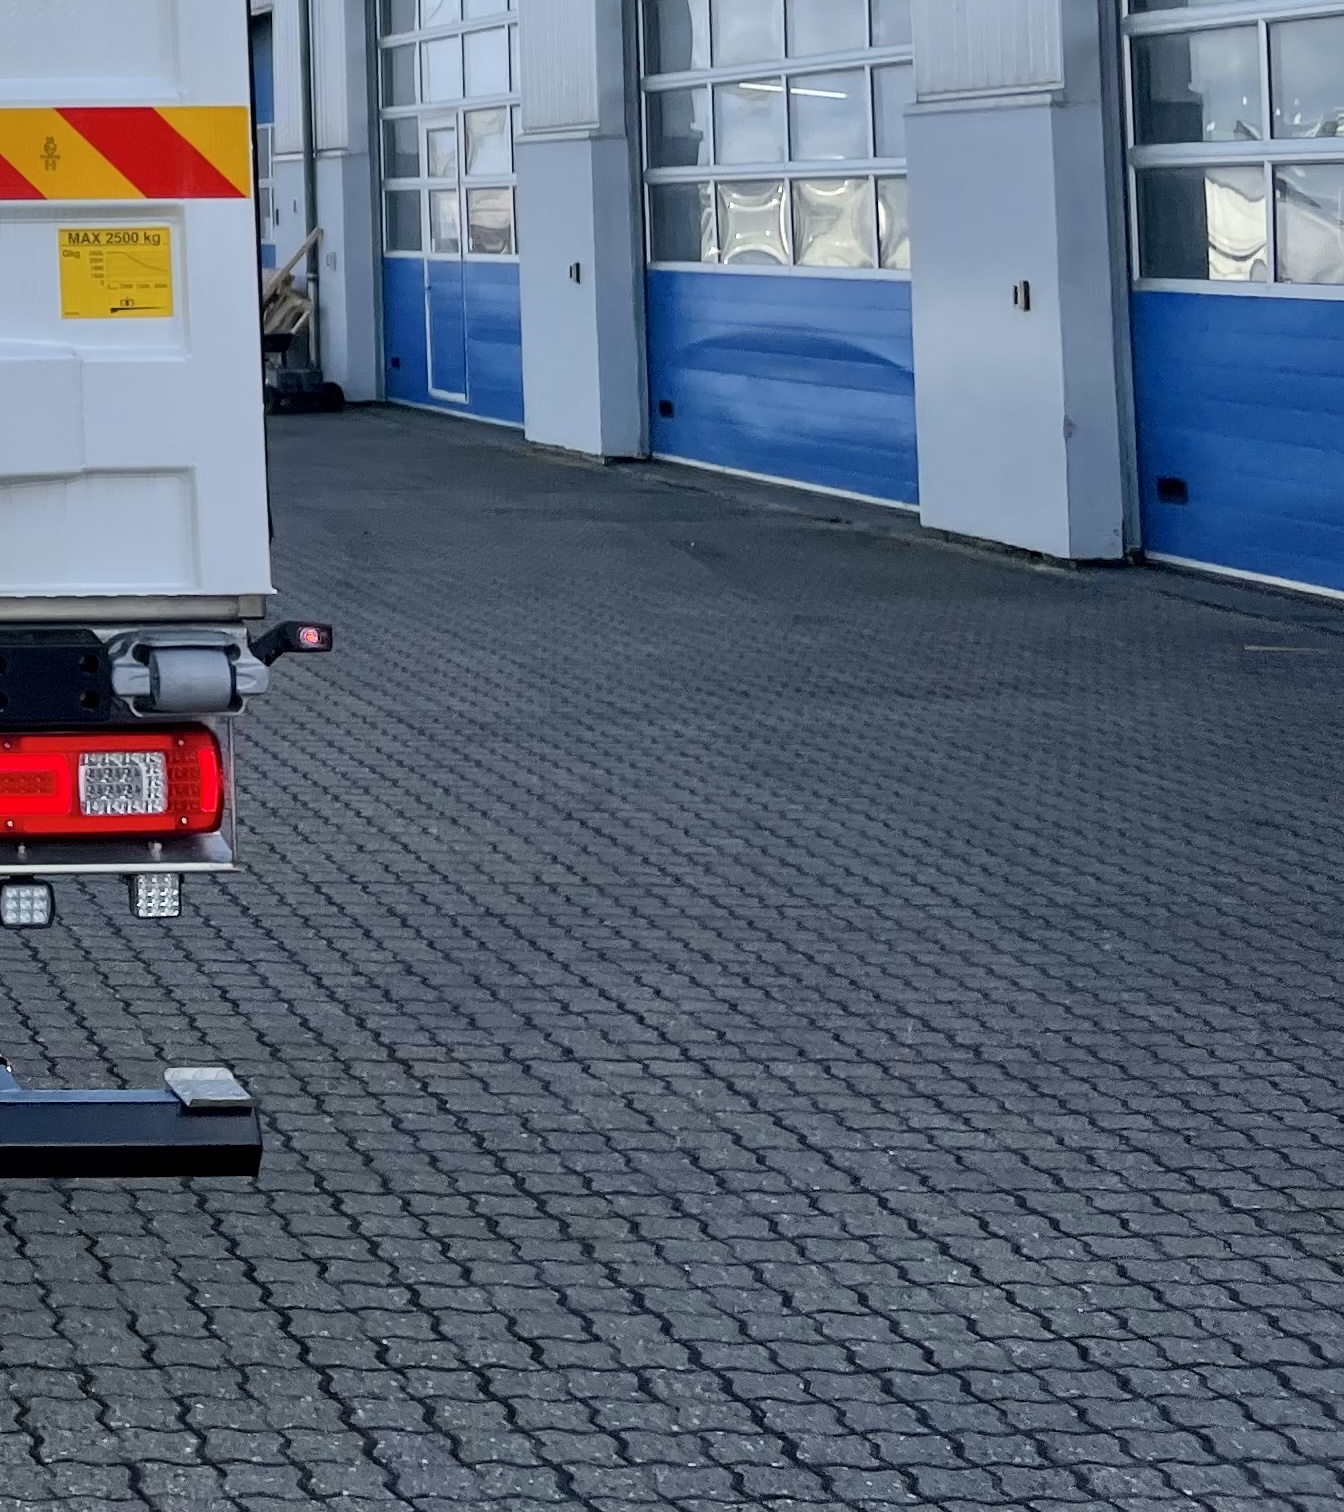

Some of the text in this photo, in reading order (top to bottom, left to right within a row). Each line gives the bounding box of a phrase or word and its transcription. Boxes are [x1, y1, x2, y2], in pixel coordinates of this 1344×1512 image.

[68, 231, 161, 246] MAX 2500 kg
